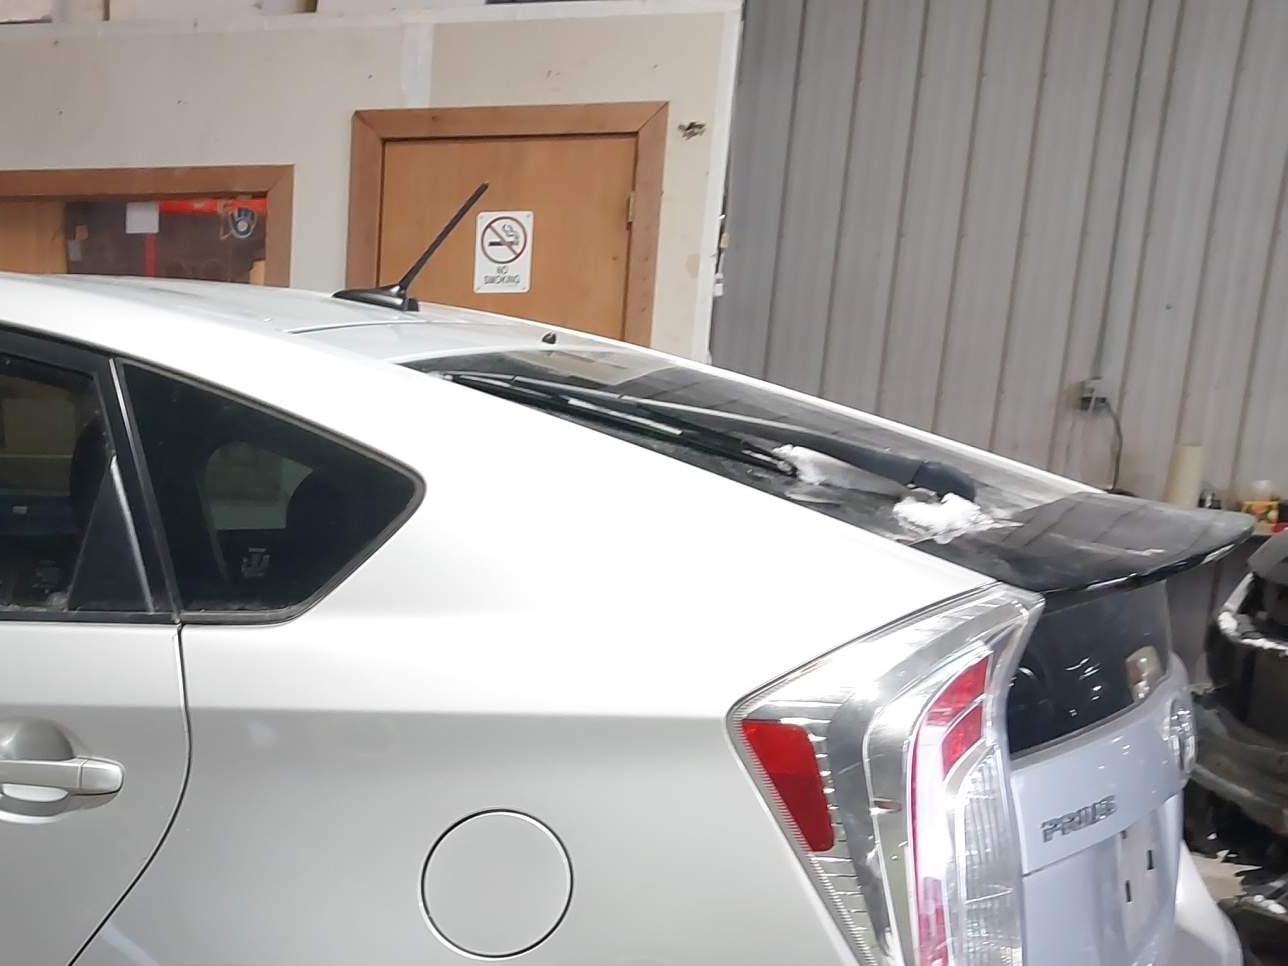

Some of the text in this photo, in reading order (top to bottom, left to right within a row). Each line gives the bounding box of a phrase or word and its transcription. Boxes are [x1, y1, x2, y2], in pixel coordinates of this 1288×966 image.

[496, 265, 509, 275] NO
[484, 275, 521, 286] SMOKING
[1040, 794, 1116, 843] PRIUS
